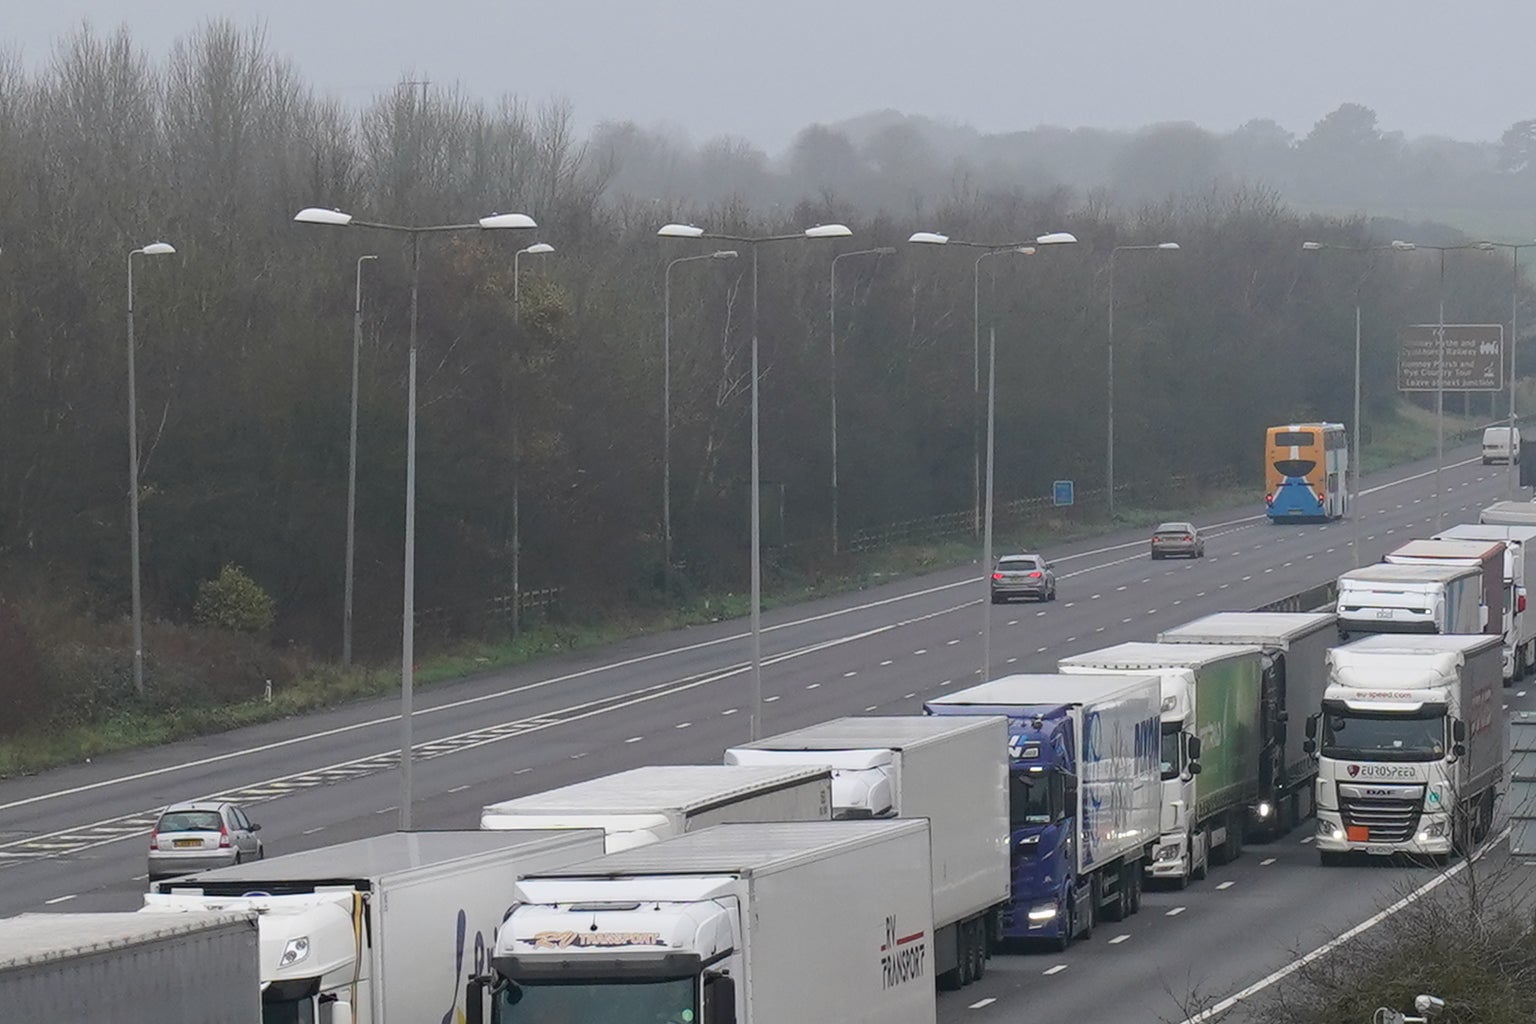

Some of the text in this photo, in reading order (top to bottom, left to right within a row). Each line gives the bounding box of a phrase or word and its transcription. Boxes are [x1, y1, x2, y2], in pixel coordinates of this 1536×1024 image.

[1461, 340, 1476, 348] and
[1461, 360, 1475, 368] and
[1356, 691, 1412, 700] eu-speed.com
[1361, 765, 1416, 777] EUROSPEED
[885, 914, 897, 949] RV
[578, 932, 660, 946] TRANSPORT
[881, 944, 924, 990] TRANSPORT
